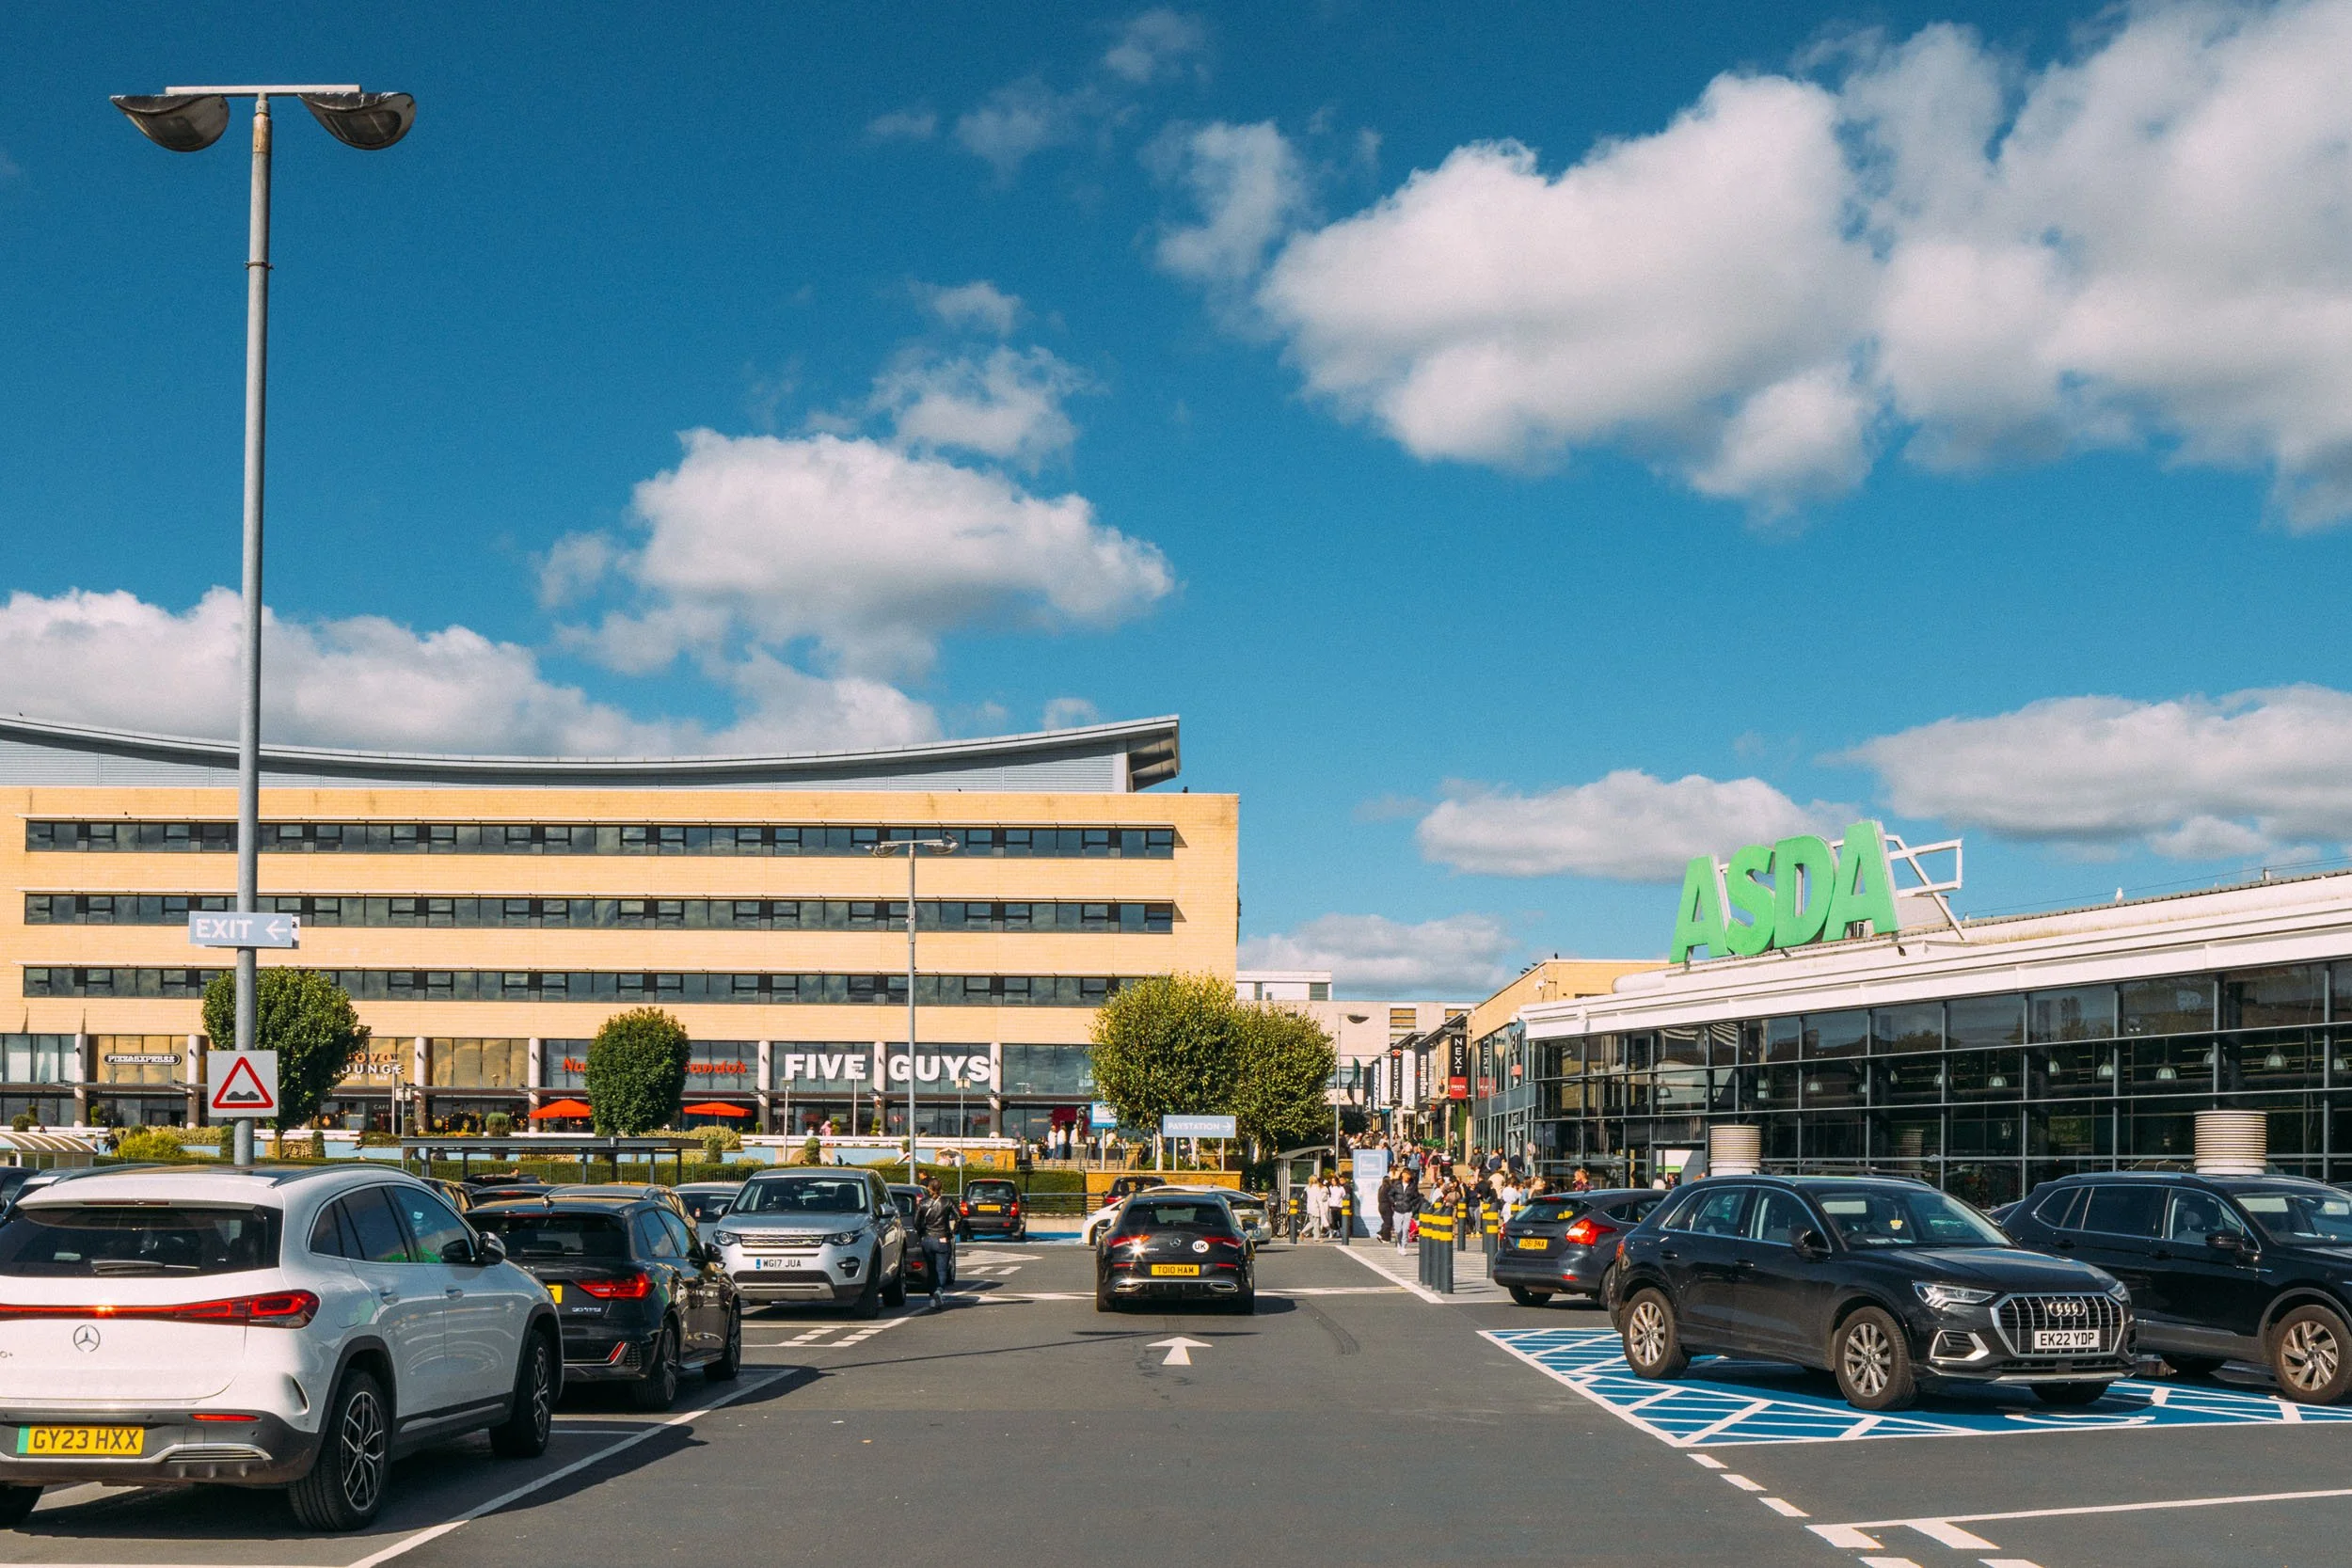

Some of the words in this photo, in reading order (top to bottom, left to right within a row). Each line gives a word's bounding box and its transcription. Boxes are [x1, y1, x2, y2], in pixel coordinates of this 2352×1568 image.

[1669, 819, 1899, 964] ASDA
[196, 918, 253, 939] EXIT
[1454, 1037, 1463, 1074] NEXT
[341, 1064, 403, 1074] OUNGE
[684, 1060, 746, 1073] ando's
[785, 1053, 866, 1080] FIVE
[888, 1054, 991, 1082] GUYS
[1420, 1054, 1428, 1097] wagamama
[785, 1259, 802, 1268] JUA
[2040, 1332, 2071, 1346] EK22
[2074, 1332, 2095, 1345] YDP
[33, 1430, 89, 1449] GY23
[95, 1430, 139, 1449] HXX
